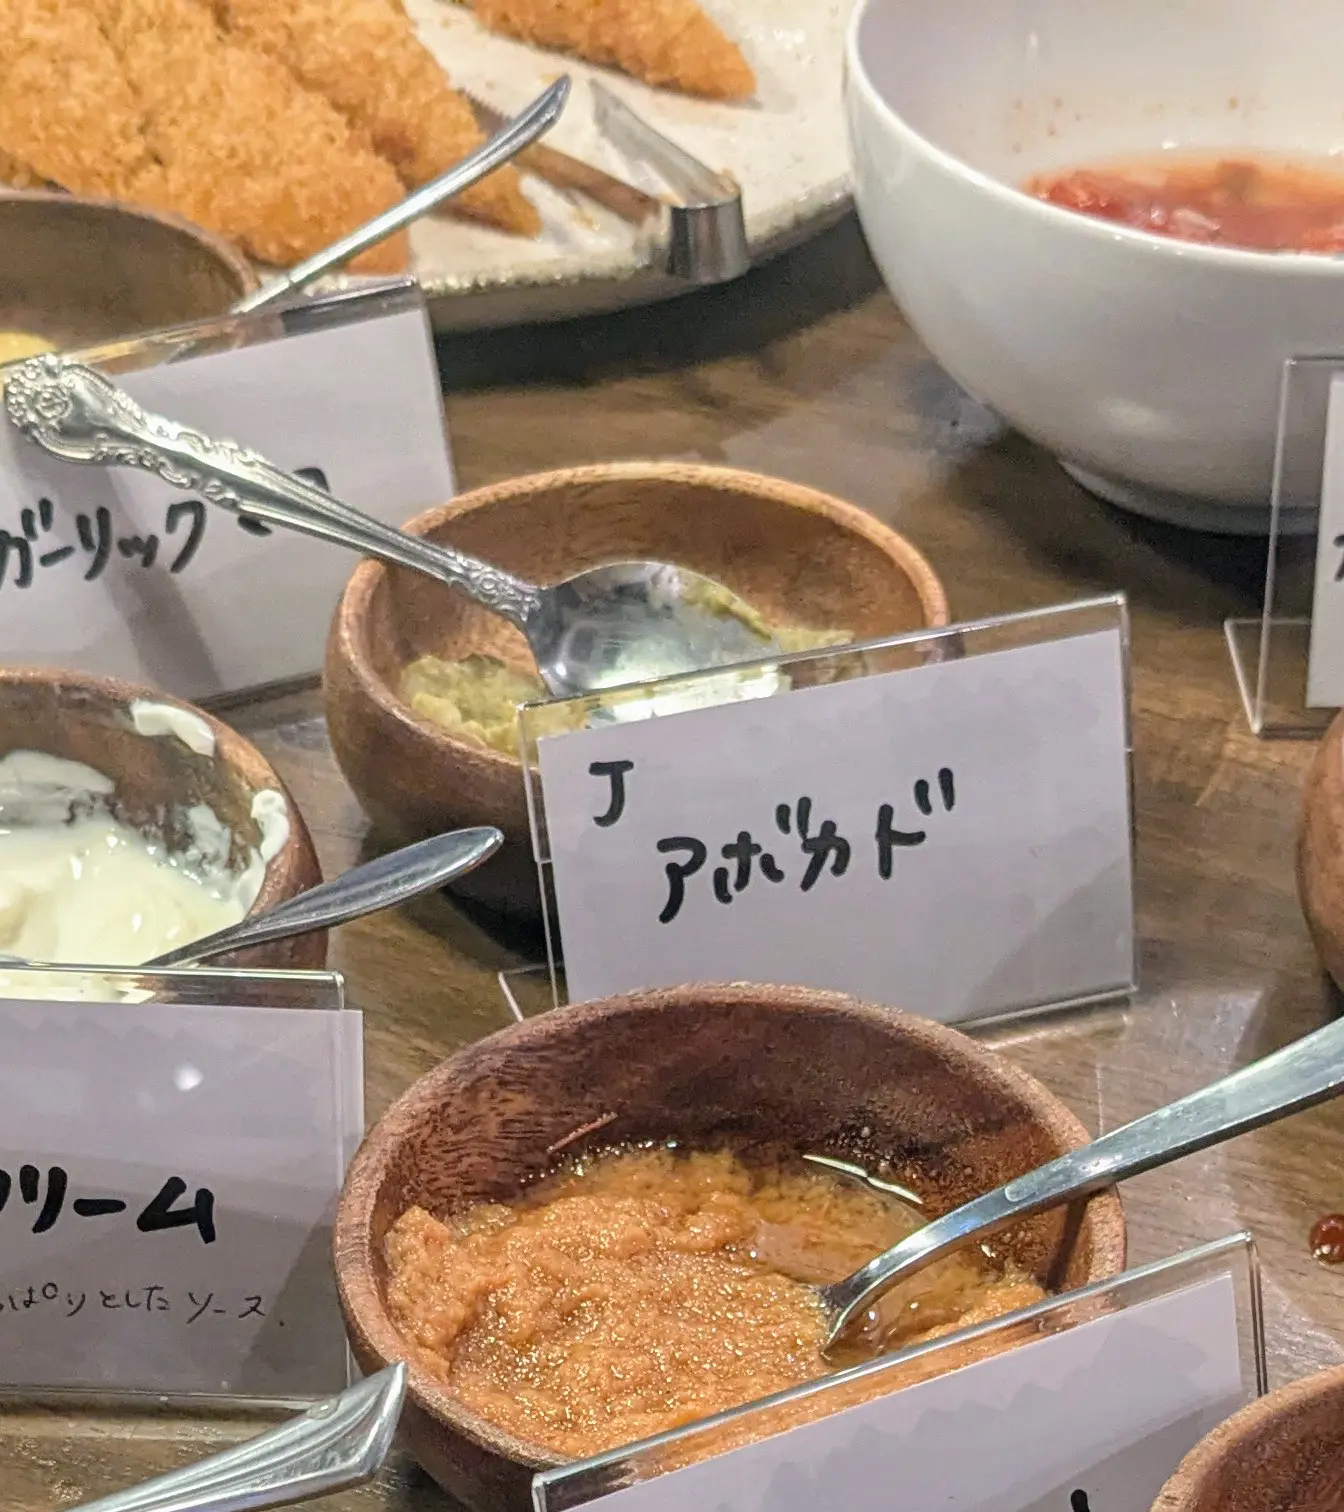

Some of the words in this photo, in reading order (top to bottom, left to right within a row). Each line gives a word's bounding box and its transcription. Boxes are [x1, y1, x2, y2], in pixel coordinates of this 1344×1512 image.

[588, 759, 635, 828] J
[656, 766, 957, 925] アボカド
